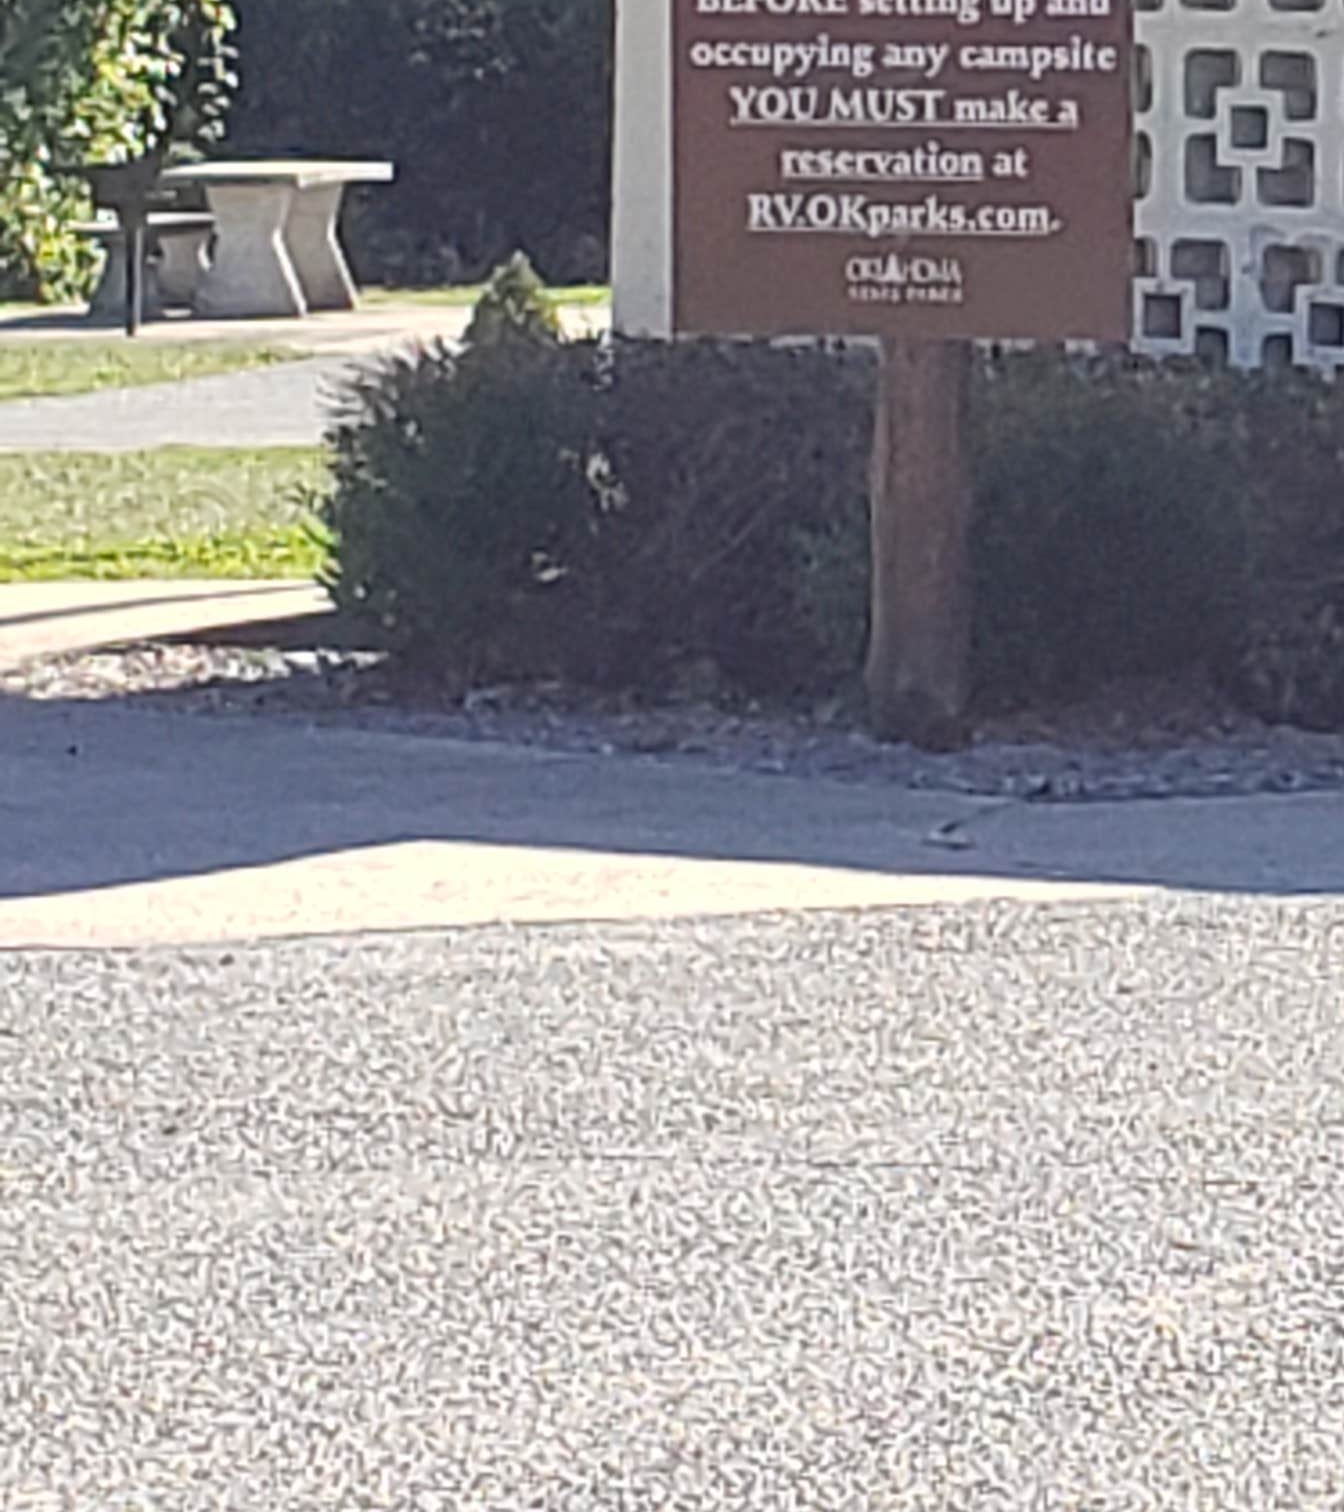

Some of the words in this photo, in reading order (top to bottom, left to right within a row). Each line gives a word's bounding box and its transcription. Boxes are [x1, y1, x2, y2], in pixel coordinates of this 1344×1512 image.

[690, 34, 874, 77] occupying
[882, 45, 949, 77] any
[959, 36, 1117, 78] campsite
[729, 87, 816, 121] YOU
[828, 88, 946, 122] MUST
[954, 90, 1048, 123] make
[1057, 99, 1079, 124] a
[781, 142, 983, 178] reservation
[992, 148, 1028, 178] at
